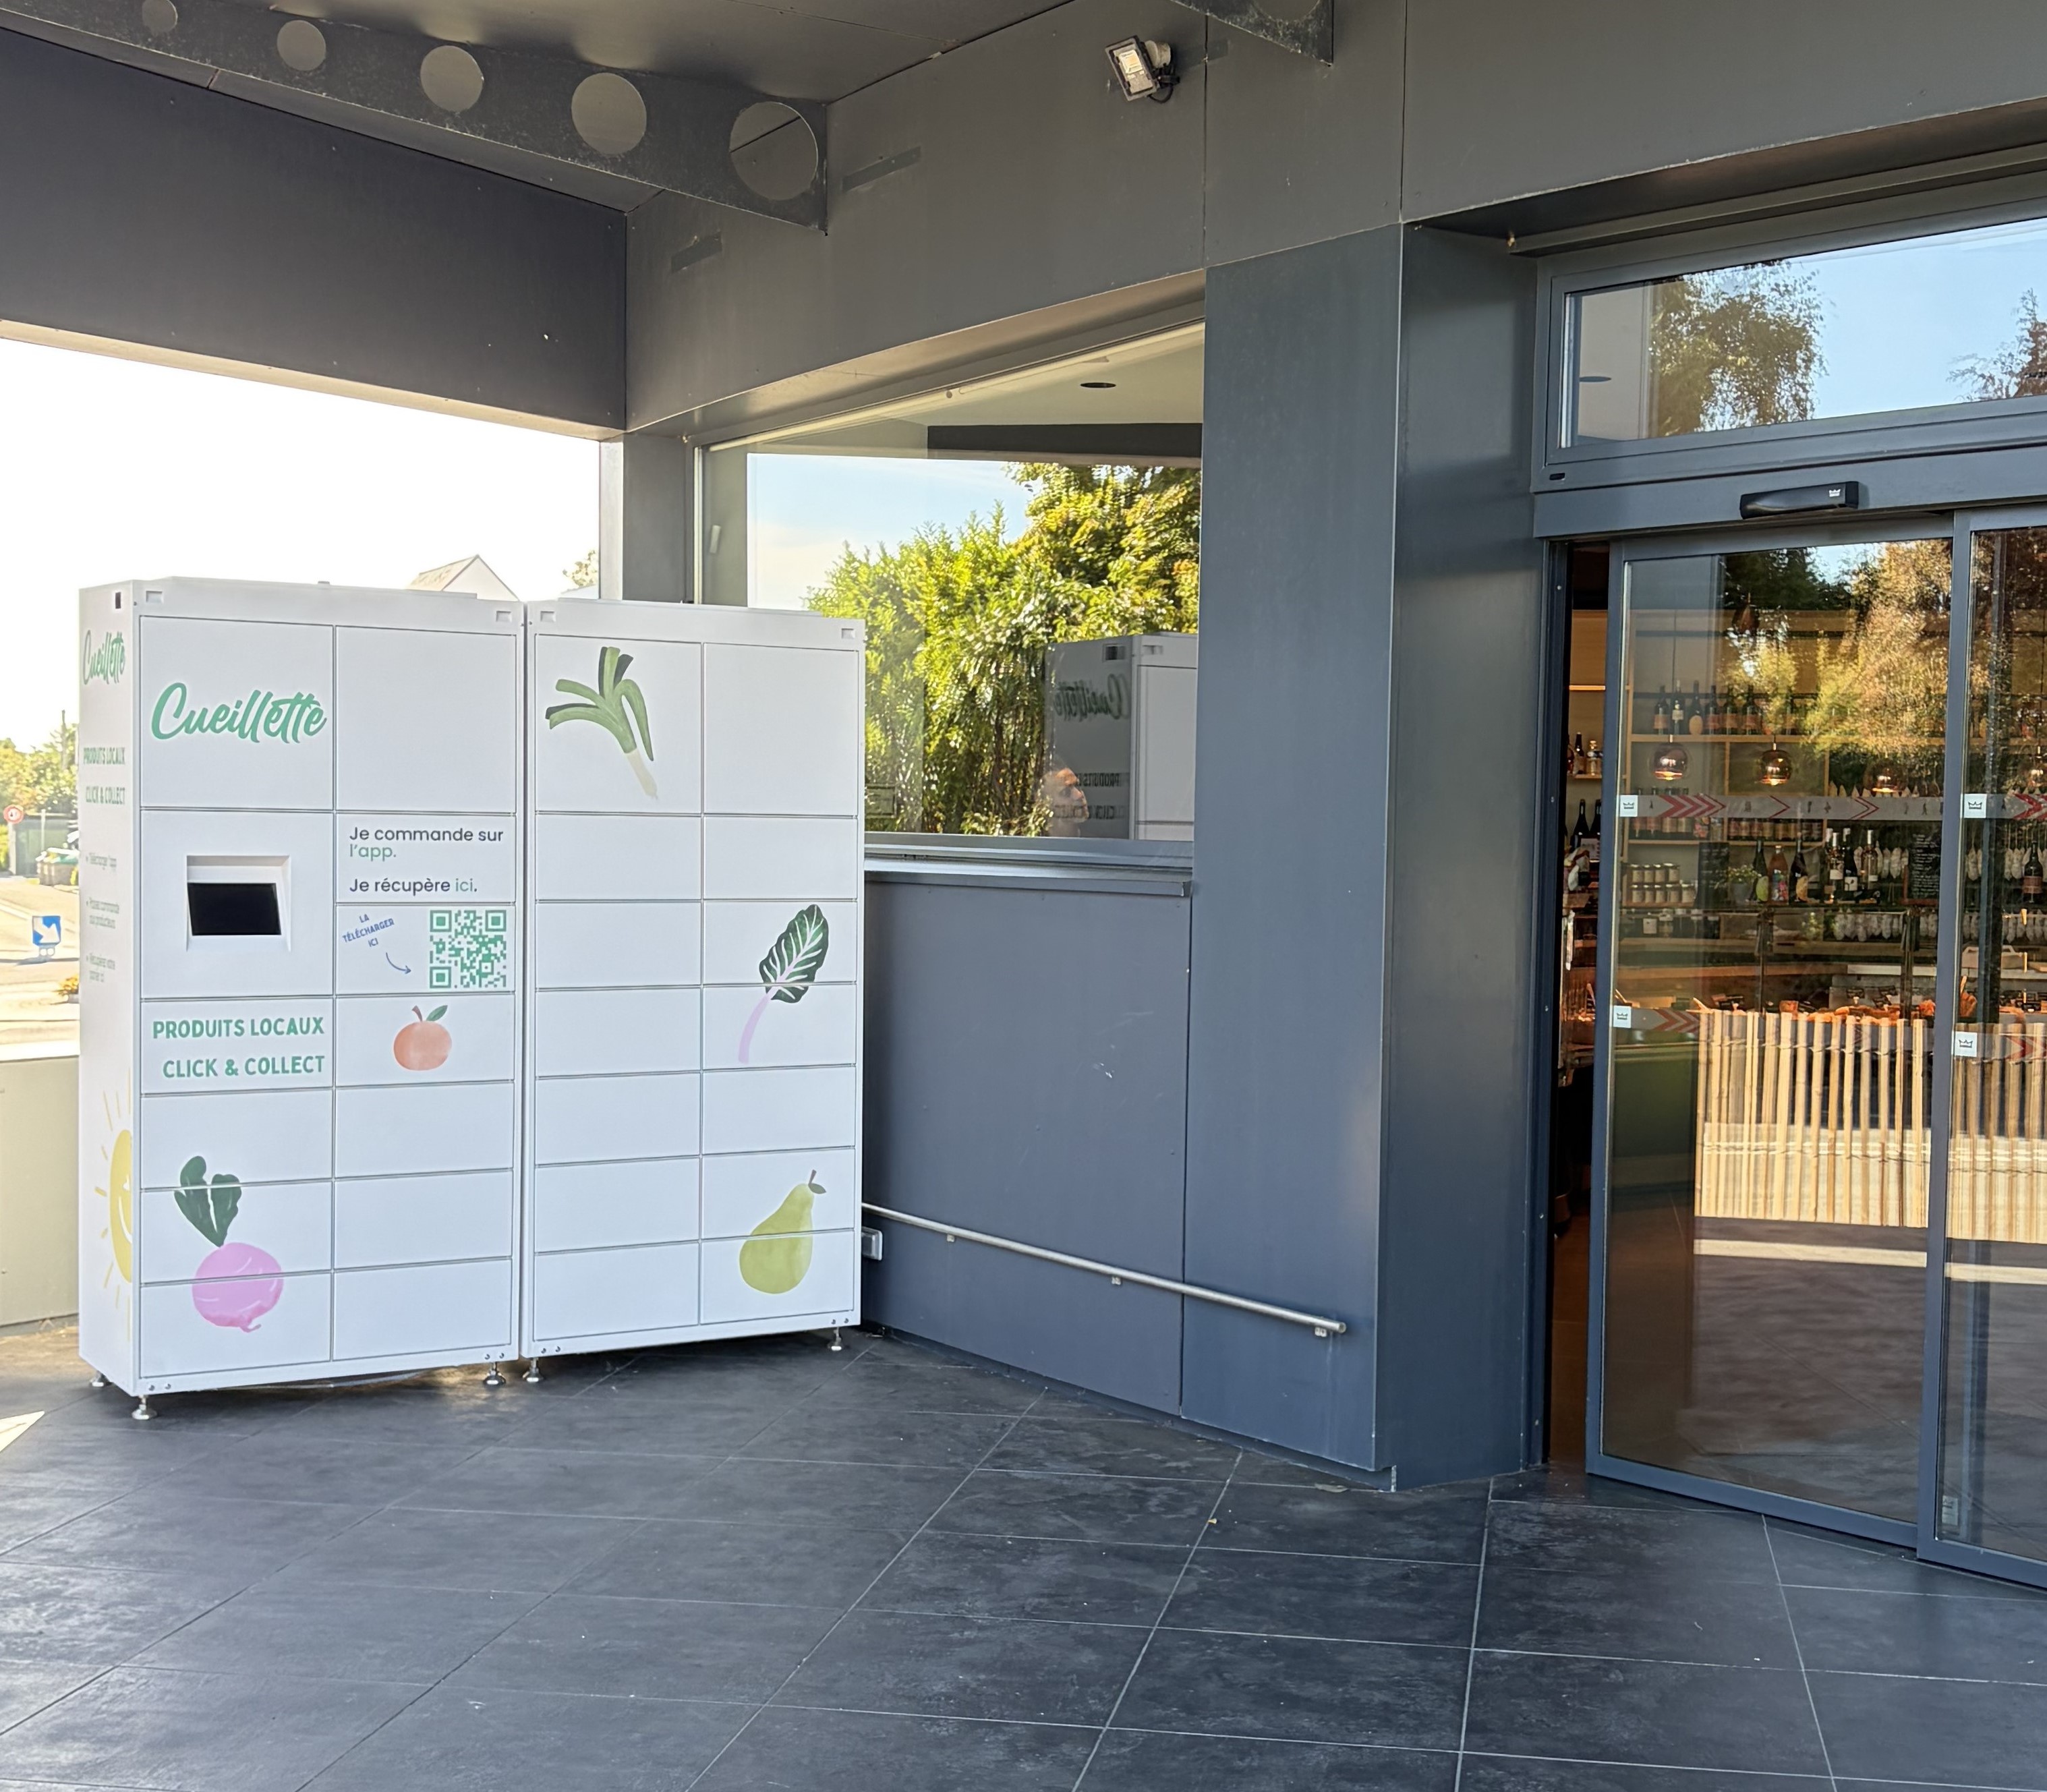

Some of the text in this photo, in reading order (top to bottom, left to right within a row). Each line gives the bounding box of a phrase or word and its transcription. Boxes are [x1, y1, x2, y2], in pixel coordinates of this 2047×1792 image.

[83, 629, 125, 685] Cueillette
[152, 683, 327, 743] Cueillette
[107, 747, 125, 765] LOCAUX
[349, 827, 504, 842] Je commande sur
[349, 844, 397, 862] l'app.
[349, 877, 478, 896] Je récupère ici.
[359, 914, 370, 923] LA
[342, 918, 395, 943] TÉLÉCHARGER
[368, 937, 379, 948] ICI
[153, 1017, 324, 1039] PRODUITS LOCAUX
[163, 1056, 324, 1078] CLICK & COLLECT
